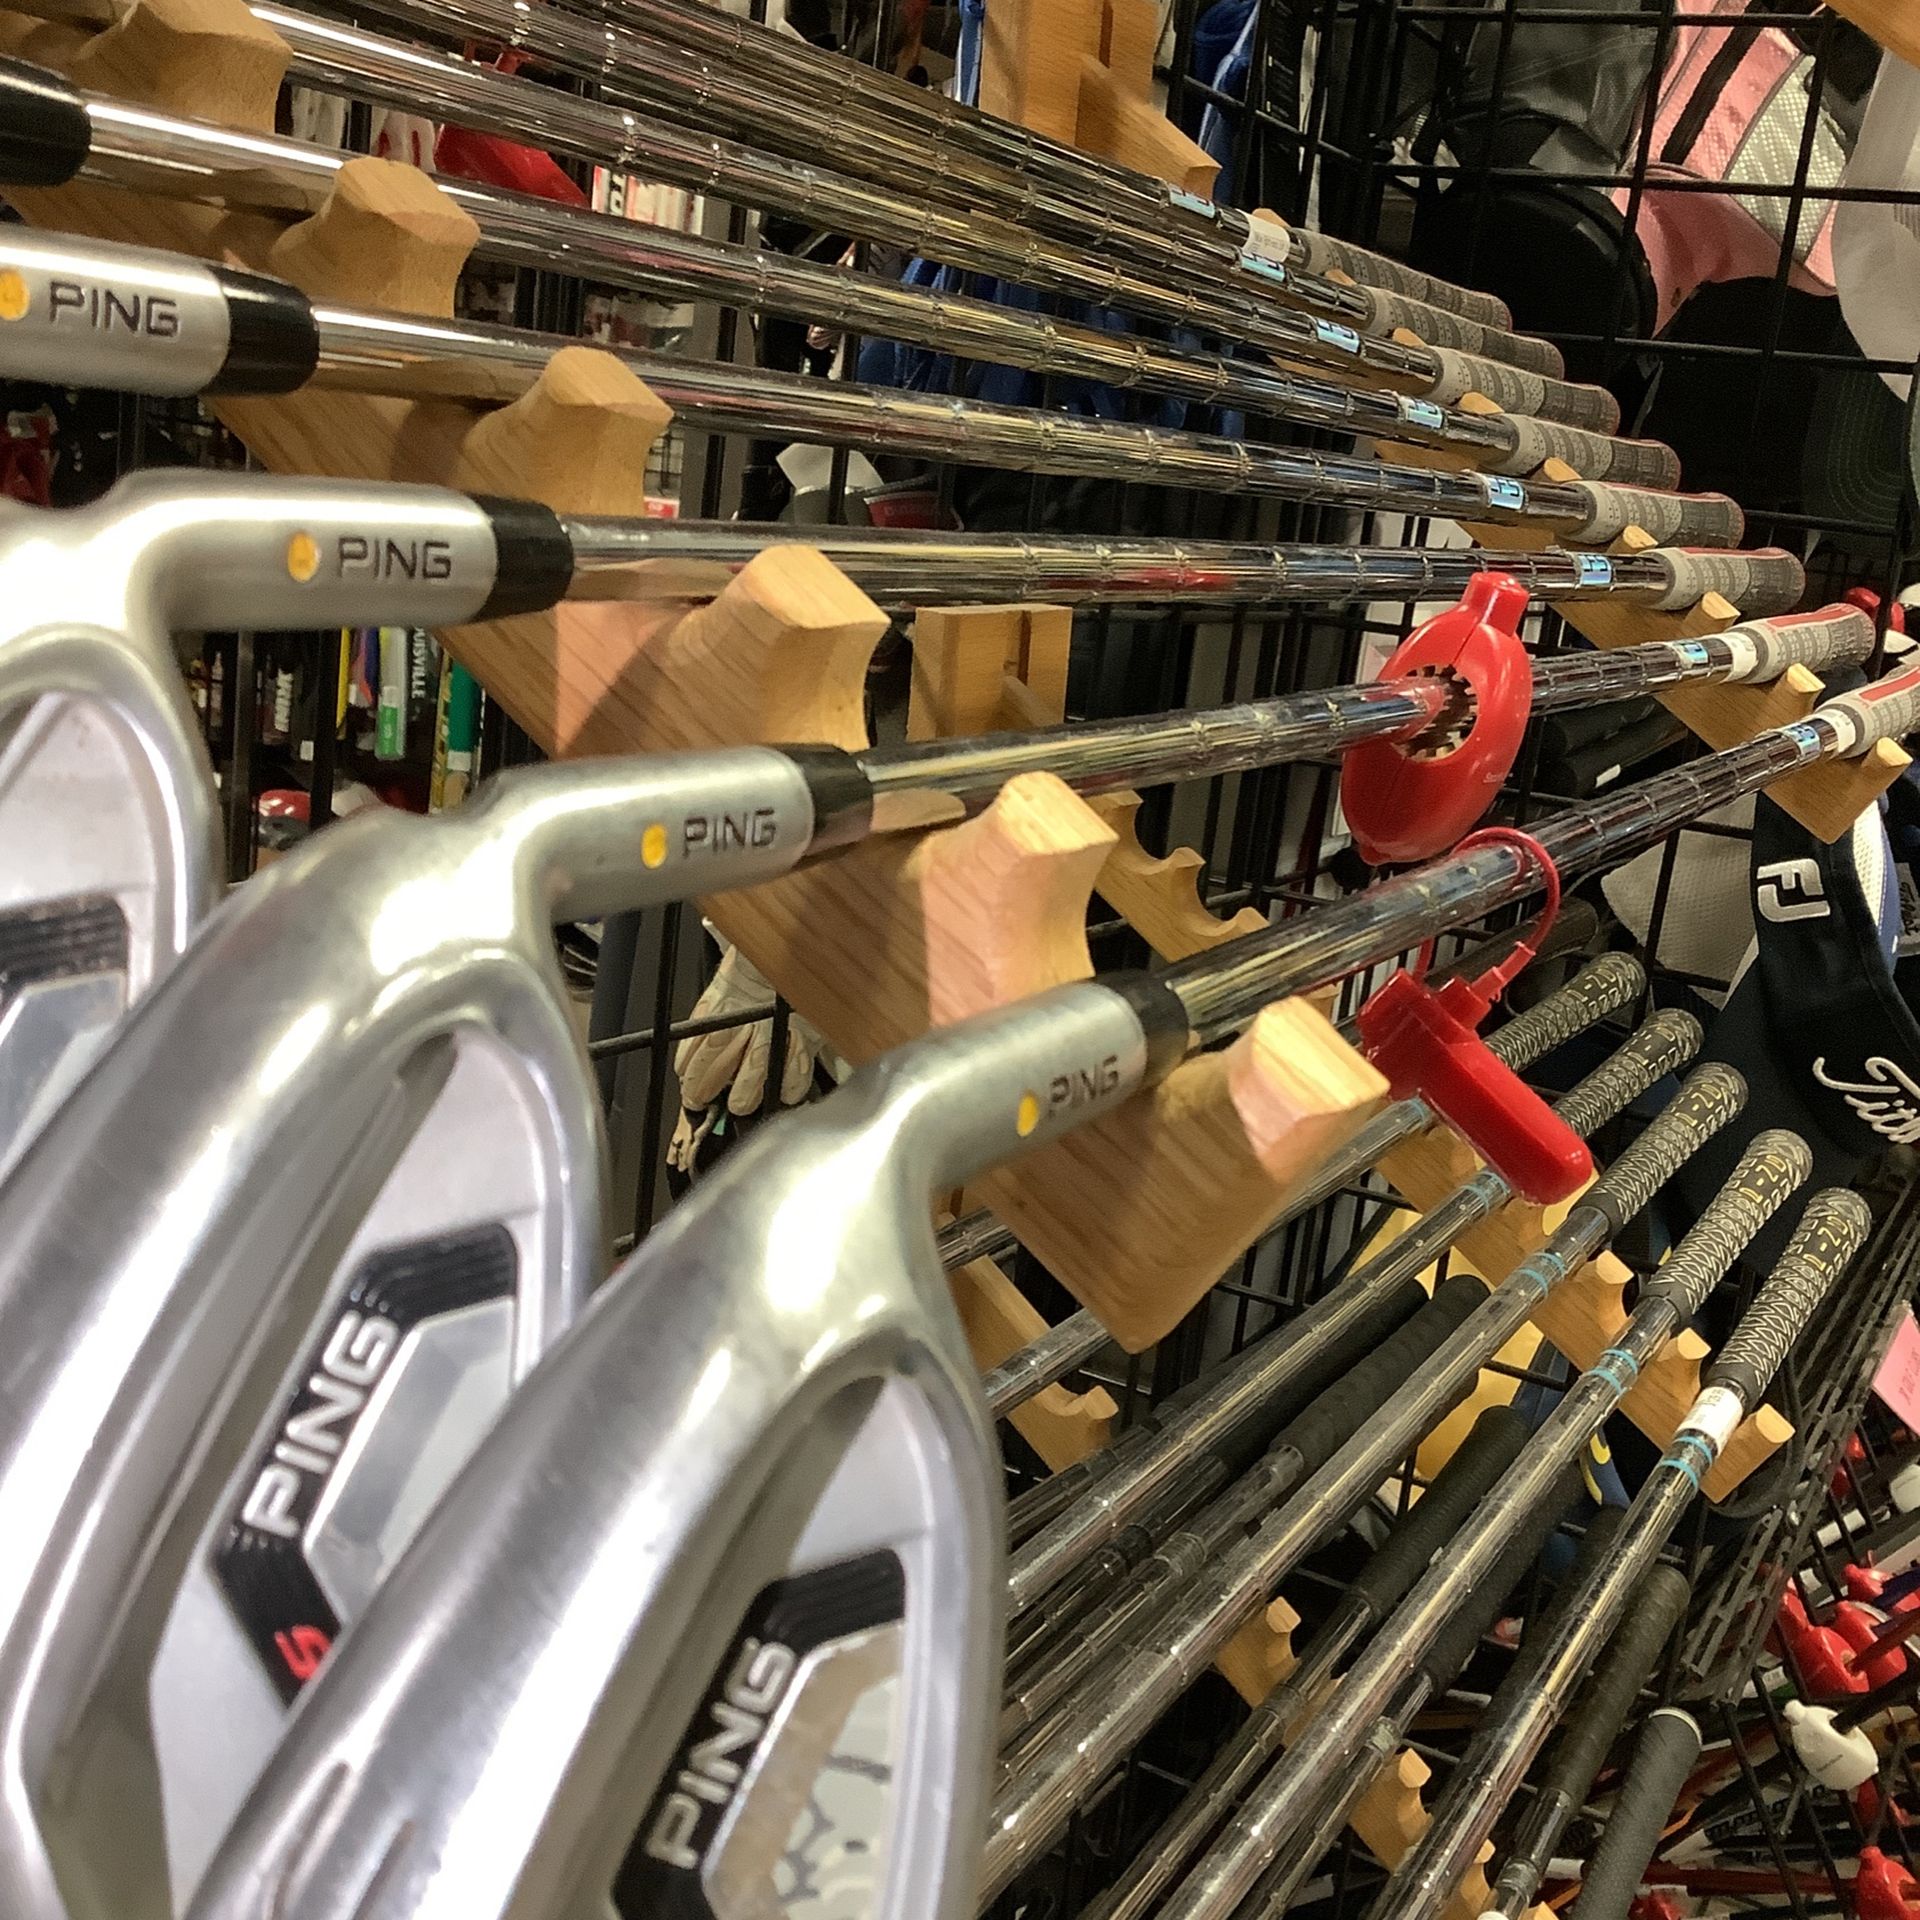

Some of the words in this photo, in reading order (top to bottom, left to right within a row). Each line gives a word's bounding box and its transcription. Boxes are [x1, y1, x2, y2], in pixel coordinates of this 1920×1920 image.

[49, 280, 180, 338] PING
[336, 536, 453, 581] PING
[682, 808, 778, 858] PING
[1756, 858, 1831, 922] FJ
[1048, 1055, 1120, 1119] PING
[241, 1308, 401, 1539] PING
[644, 1636, 798, 1870] PING
